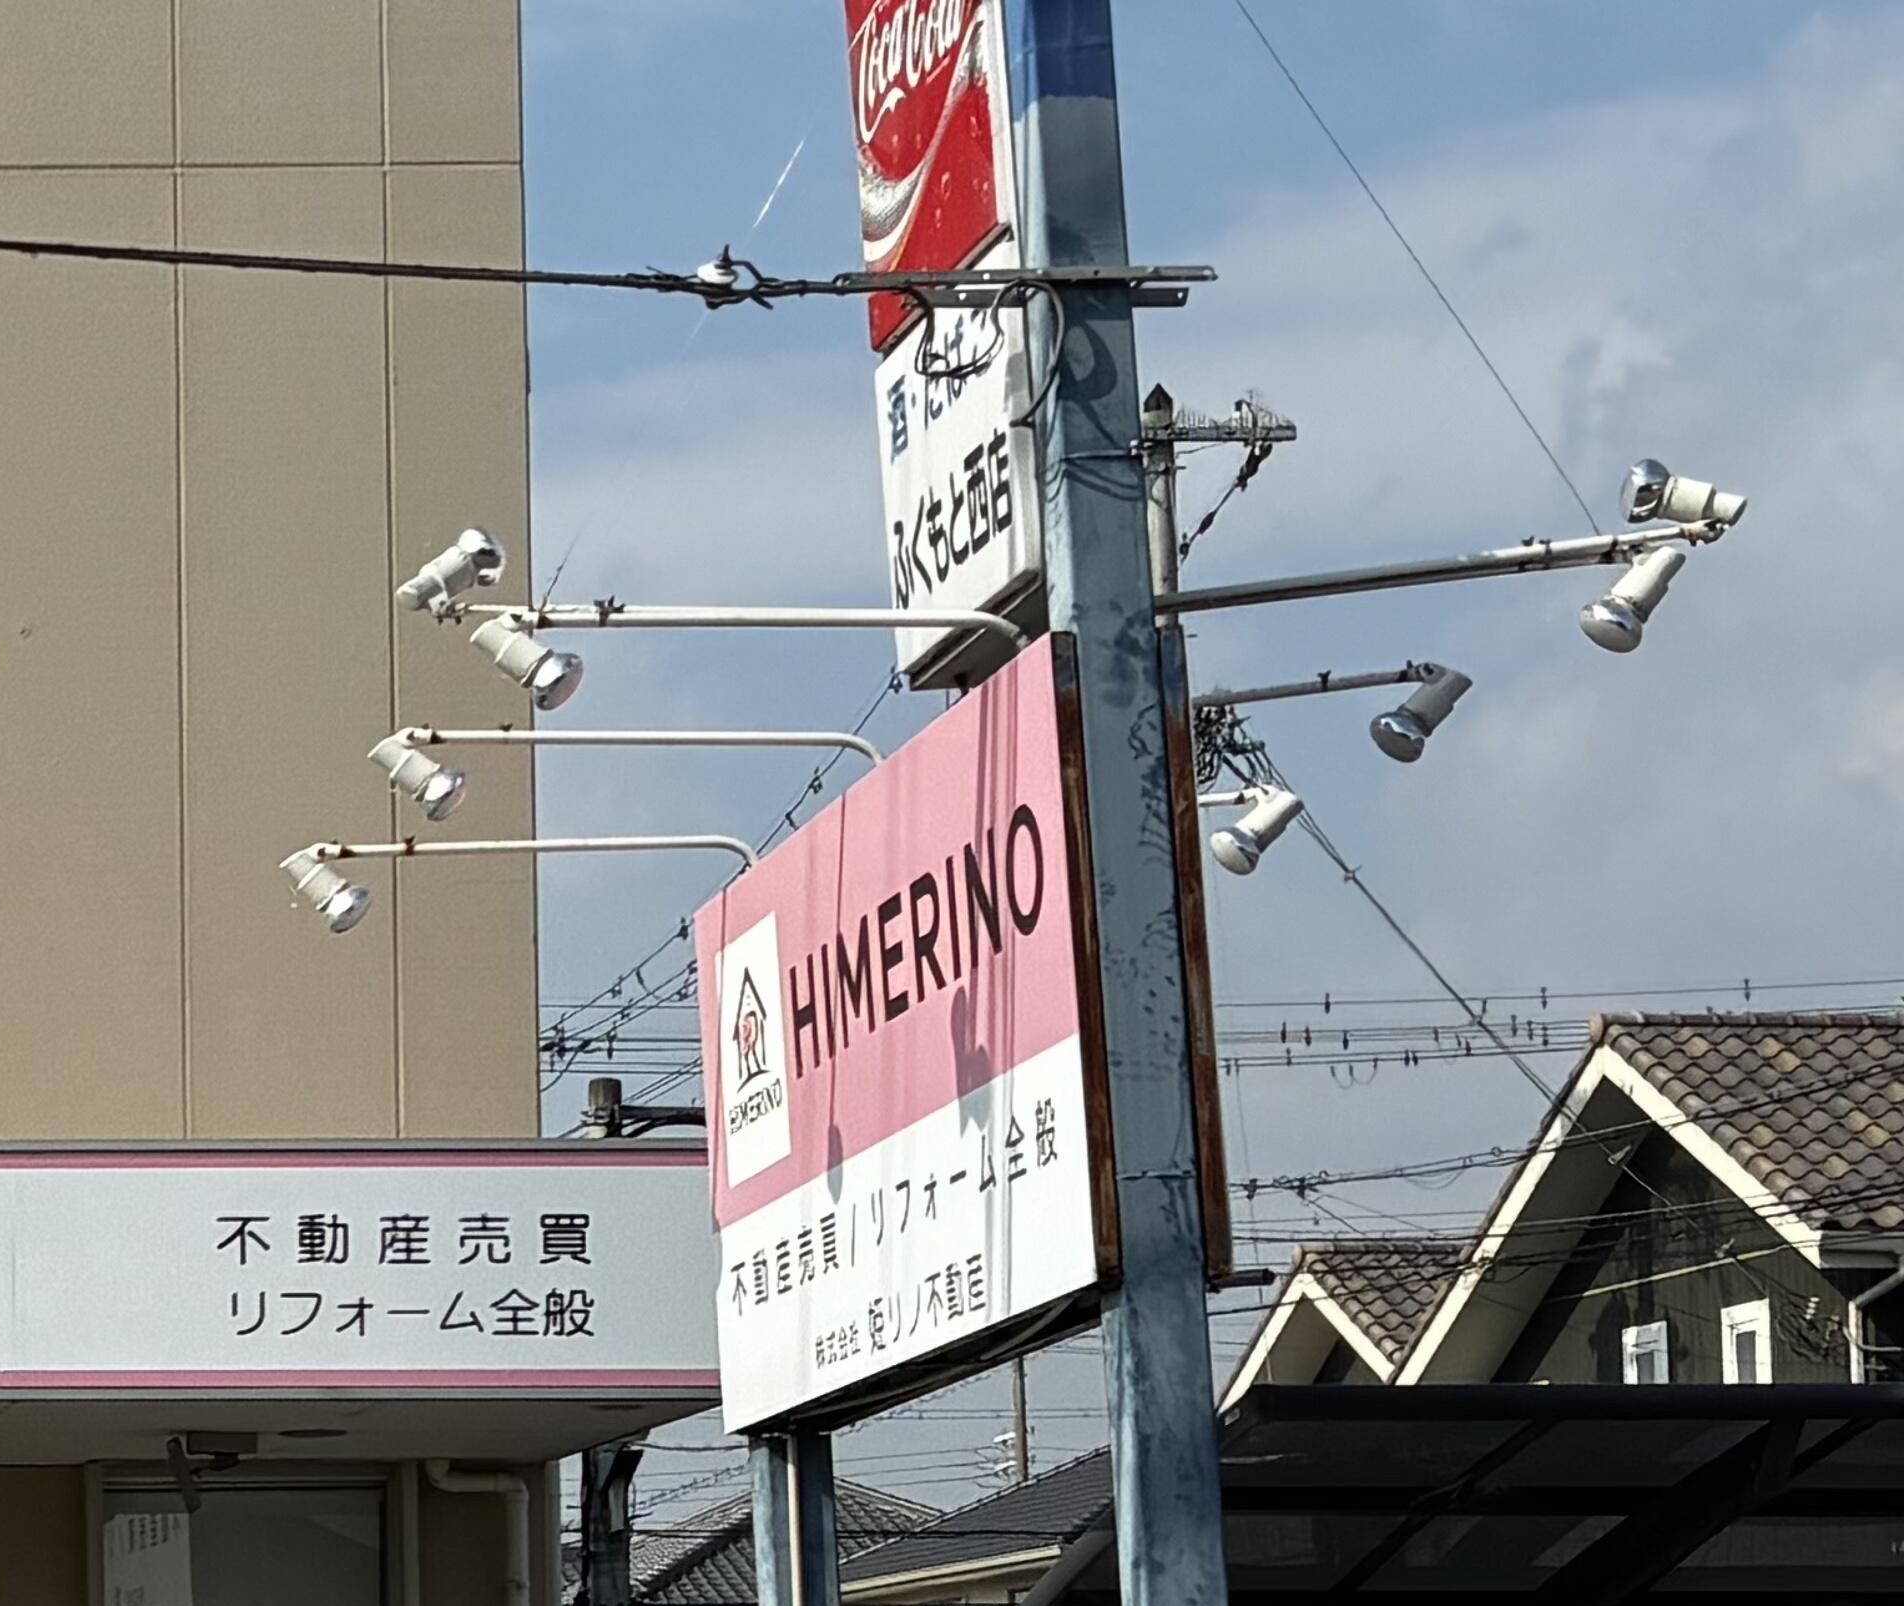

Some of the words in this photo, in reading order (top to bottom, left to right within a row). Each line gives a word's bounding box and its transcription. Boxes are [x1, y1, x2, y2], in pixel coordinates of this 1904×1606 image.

[786, 802, 1045, 1079] HIMERINO
[216, 1213, 593, 1265] 不動産売買
[231, 1287, 595, 1338] リフォーム全般
